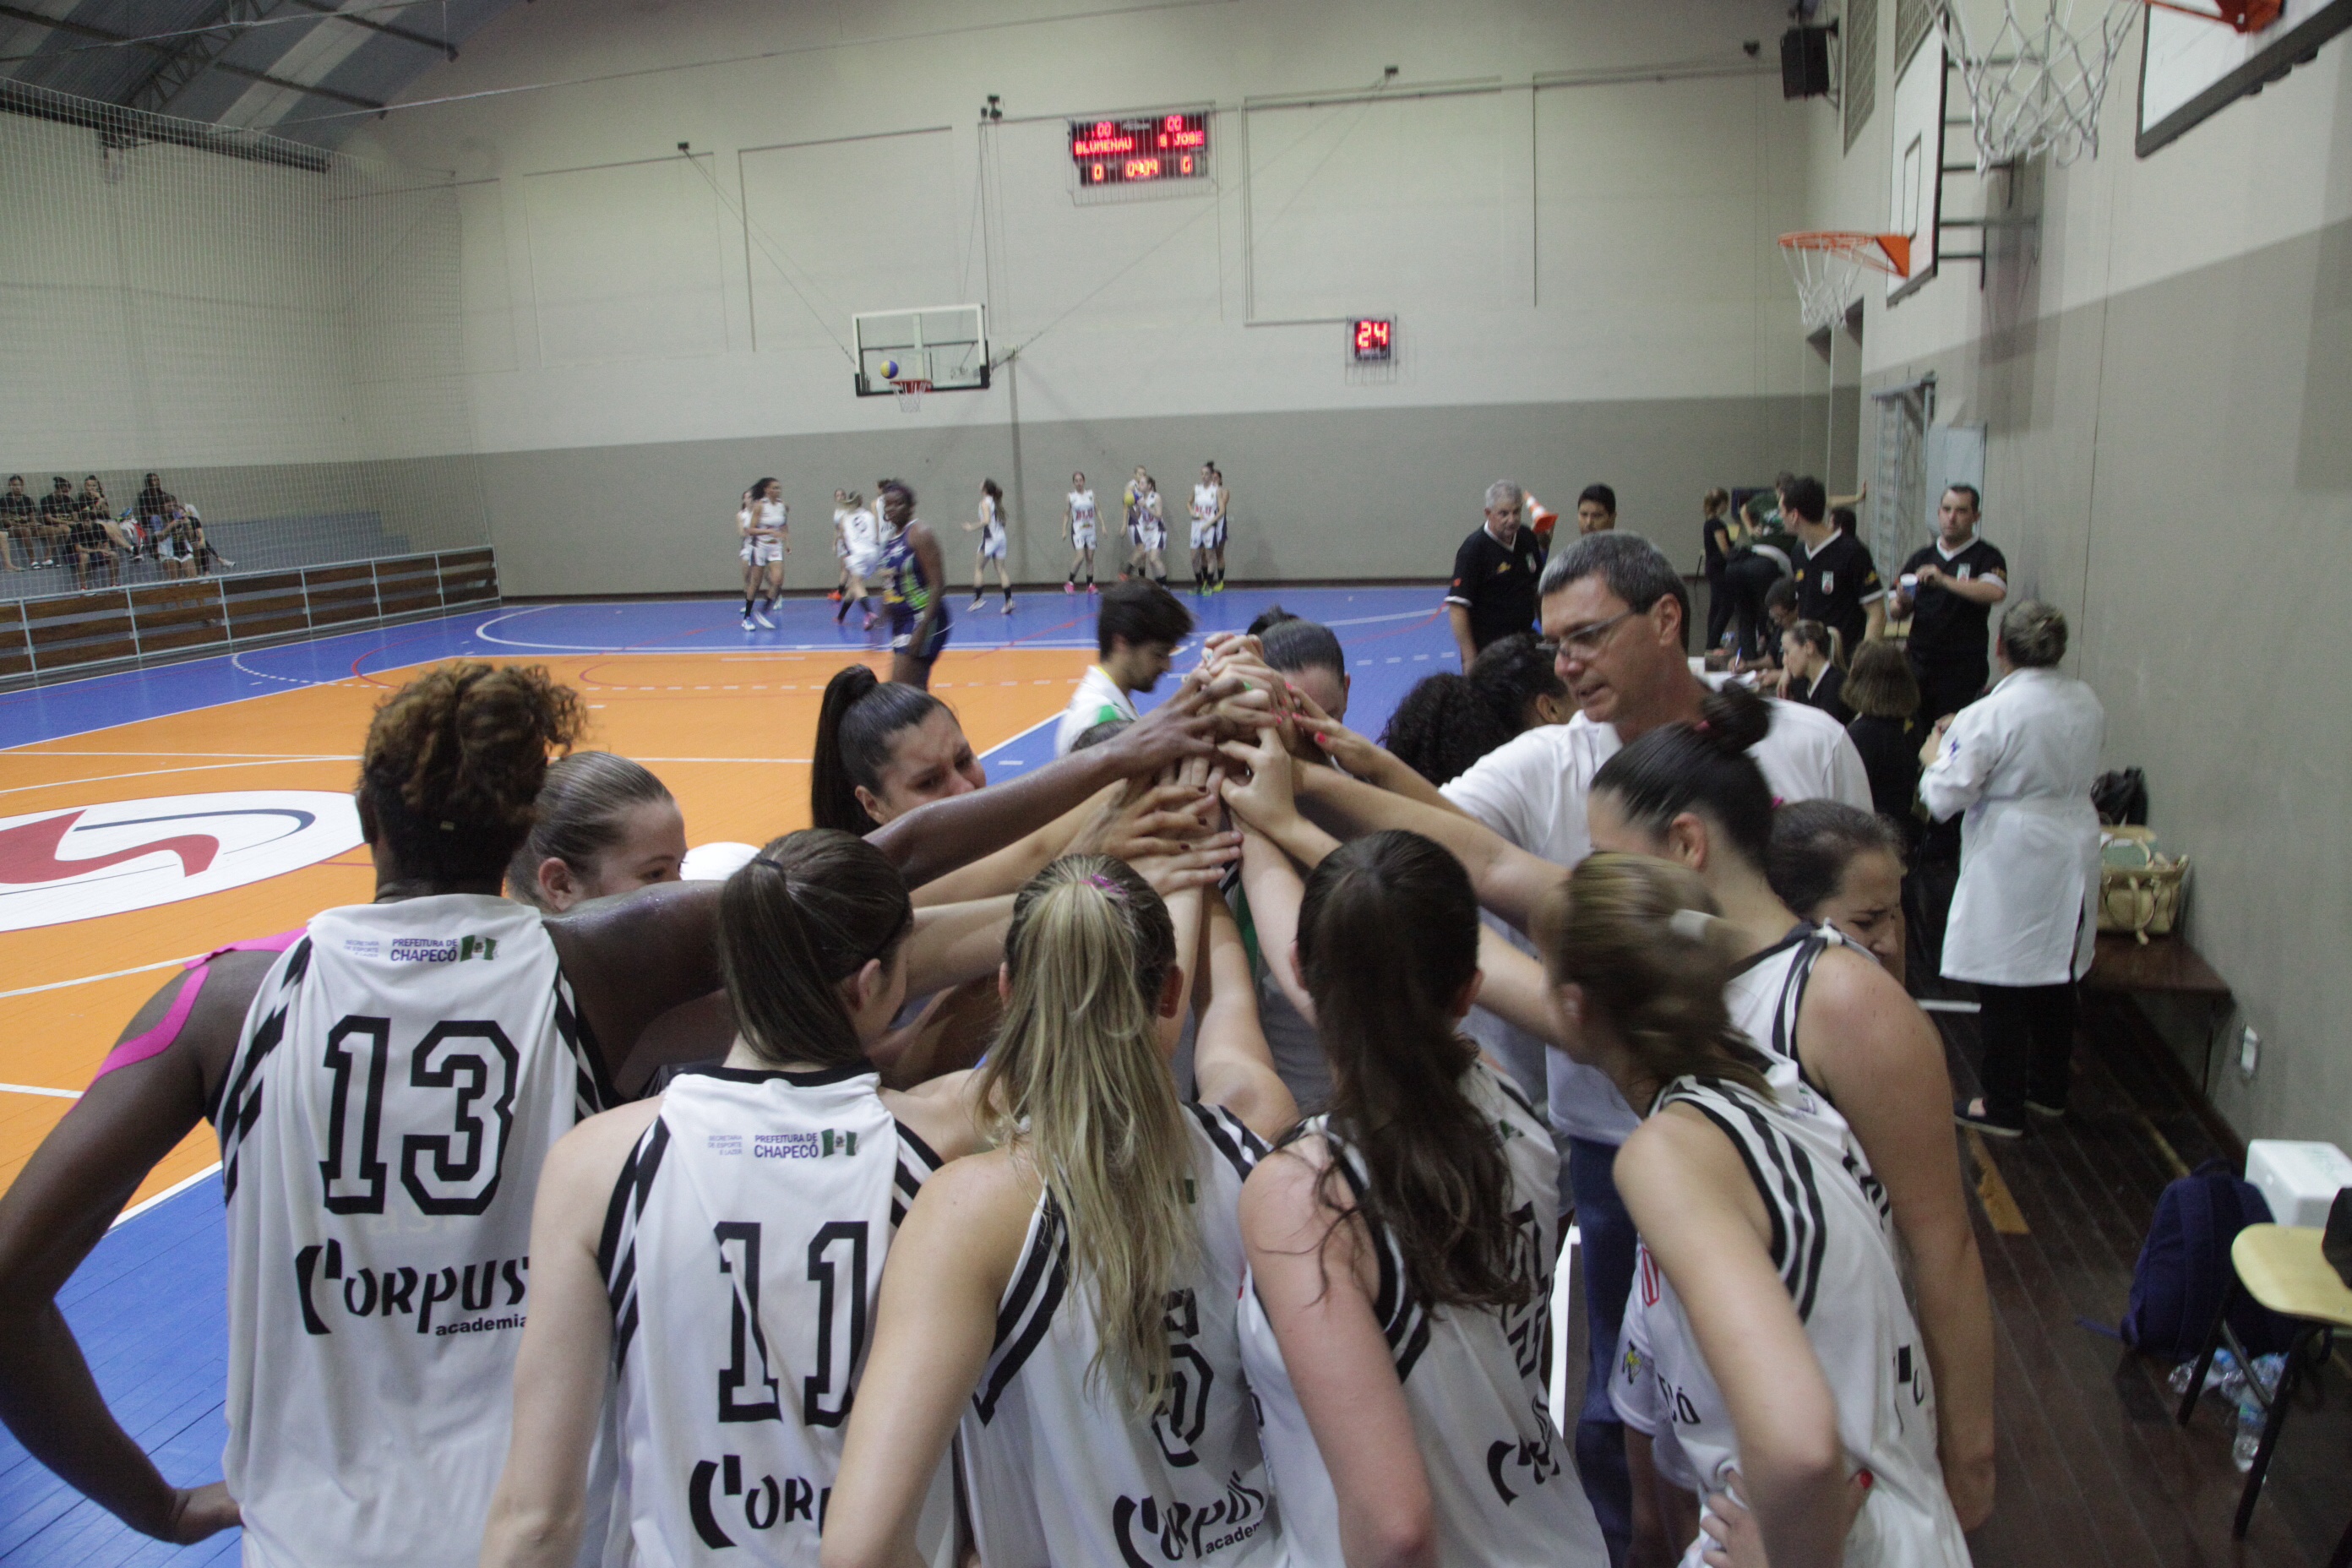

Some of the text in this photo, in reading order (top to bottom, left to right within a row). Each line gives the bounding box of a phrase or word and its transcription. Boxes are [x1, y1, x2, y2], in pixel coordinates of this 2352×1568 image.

[1075, 136, 1134, 155] BLUMENAU
[1173, 130, 1204, 147] JOSE
[1092, 163, 1104, 181] 0
[1358, 320, 1388, 348] 24
[392, 939, 458, 947] PREFEITURA DE
[390, 946, 457, 962] CHAPECÓ
[318, 1015, 520, 1217] 13
[754, 1133, 818, 1144] PREFEITURA DE
[754, 1141, 819, 1158] CHAPECÓ
[713, 1221, 868, 1428] 11
